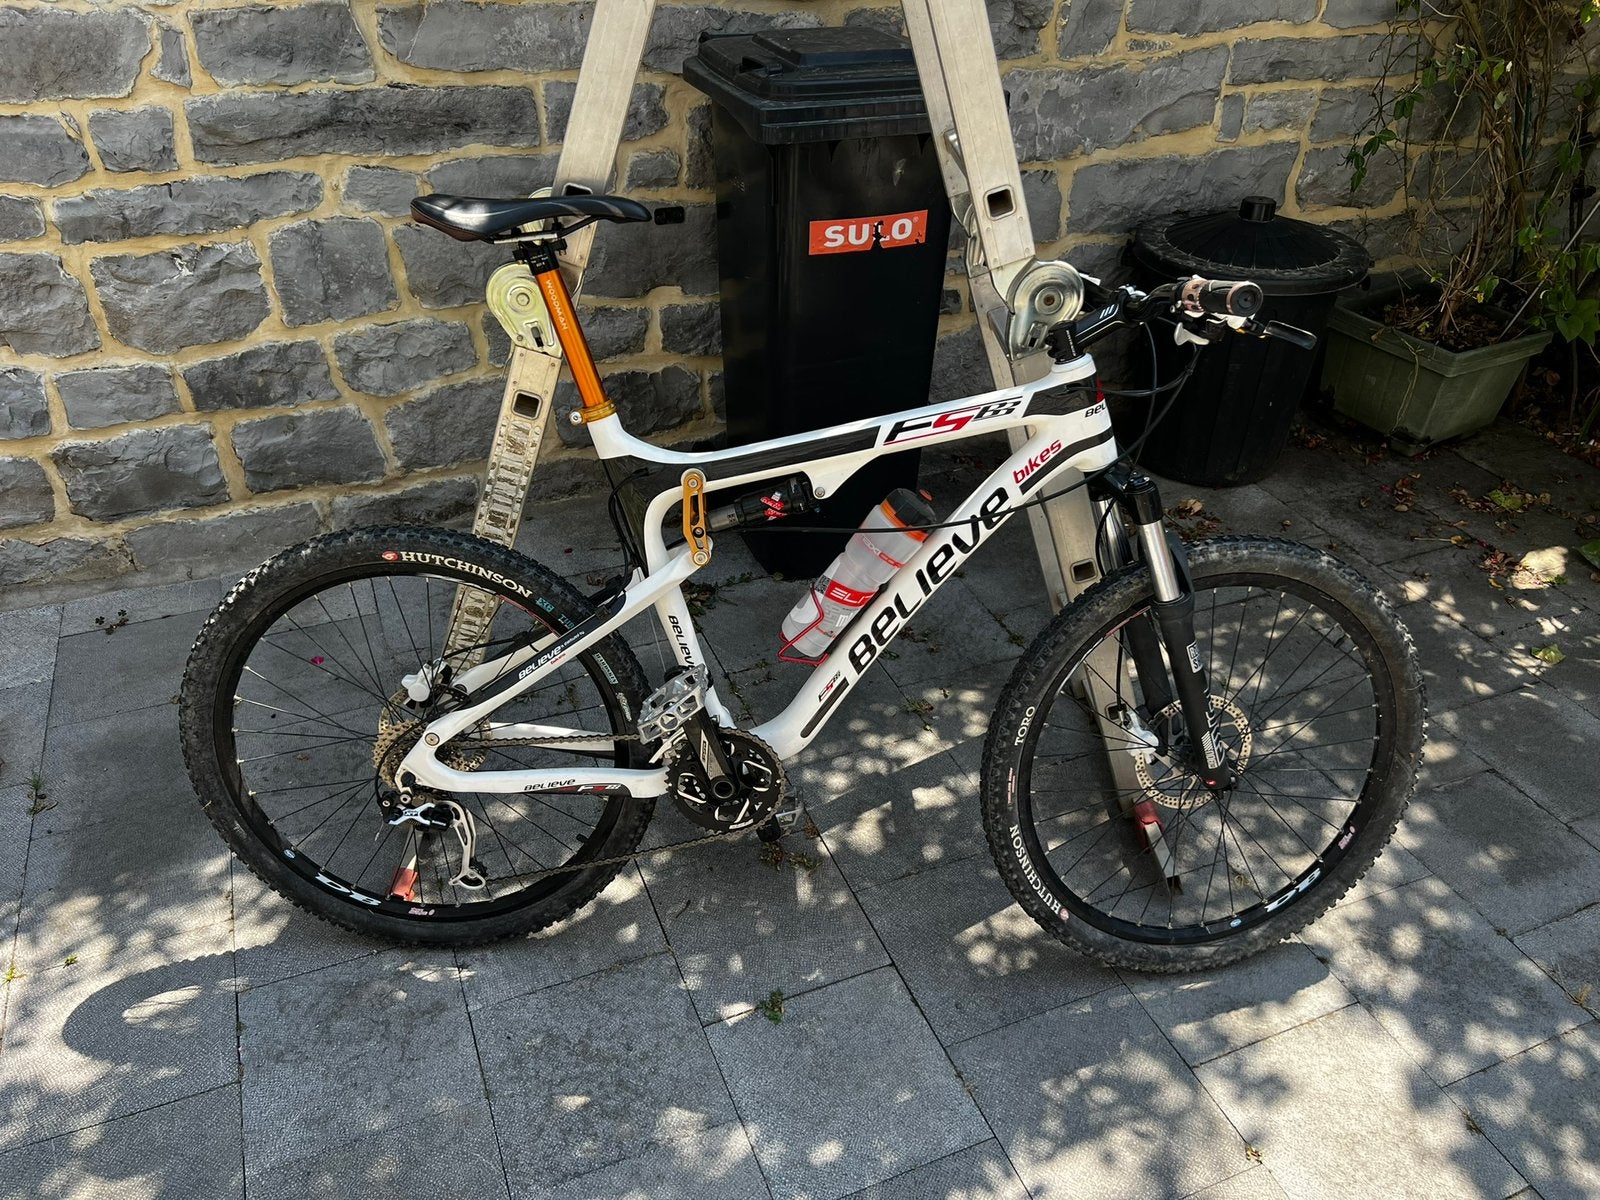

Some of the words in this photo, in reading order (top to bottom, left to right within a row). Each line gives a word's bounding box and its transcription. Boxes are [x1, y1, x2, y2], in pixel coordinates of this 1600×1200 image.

[823, 218, 913, 248] SULO
[545, 280, 568, 330] WOODMAN
[1013, 440, 1062, 485] bikes
[401, 551, 533, 598] HUTCHINSON
[1014, 706, 1036, 746] TORO
[1009, 824, 1061, 915] HUTCHINSON
